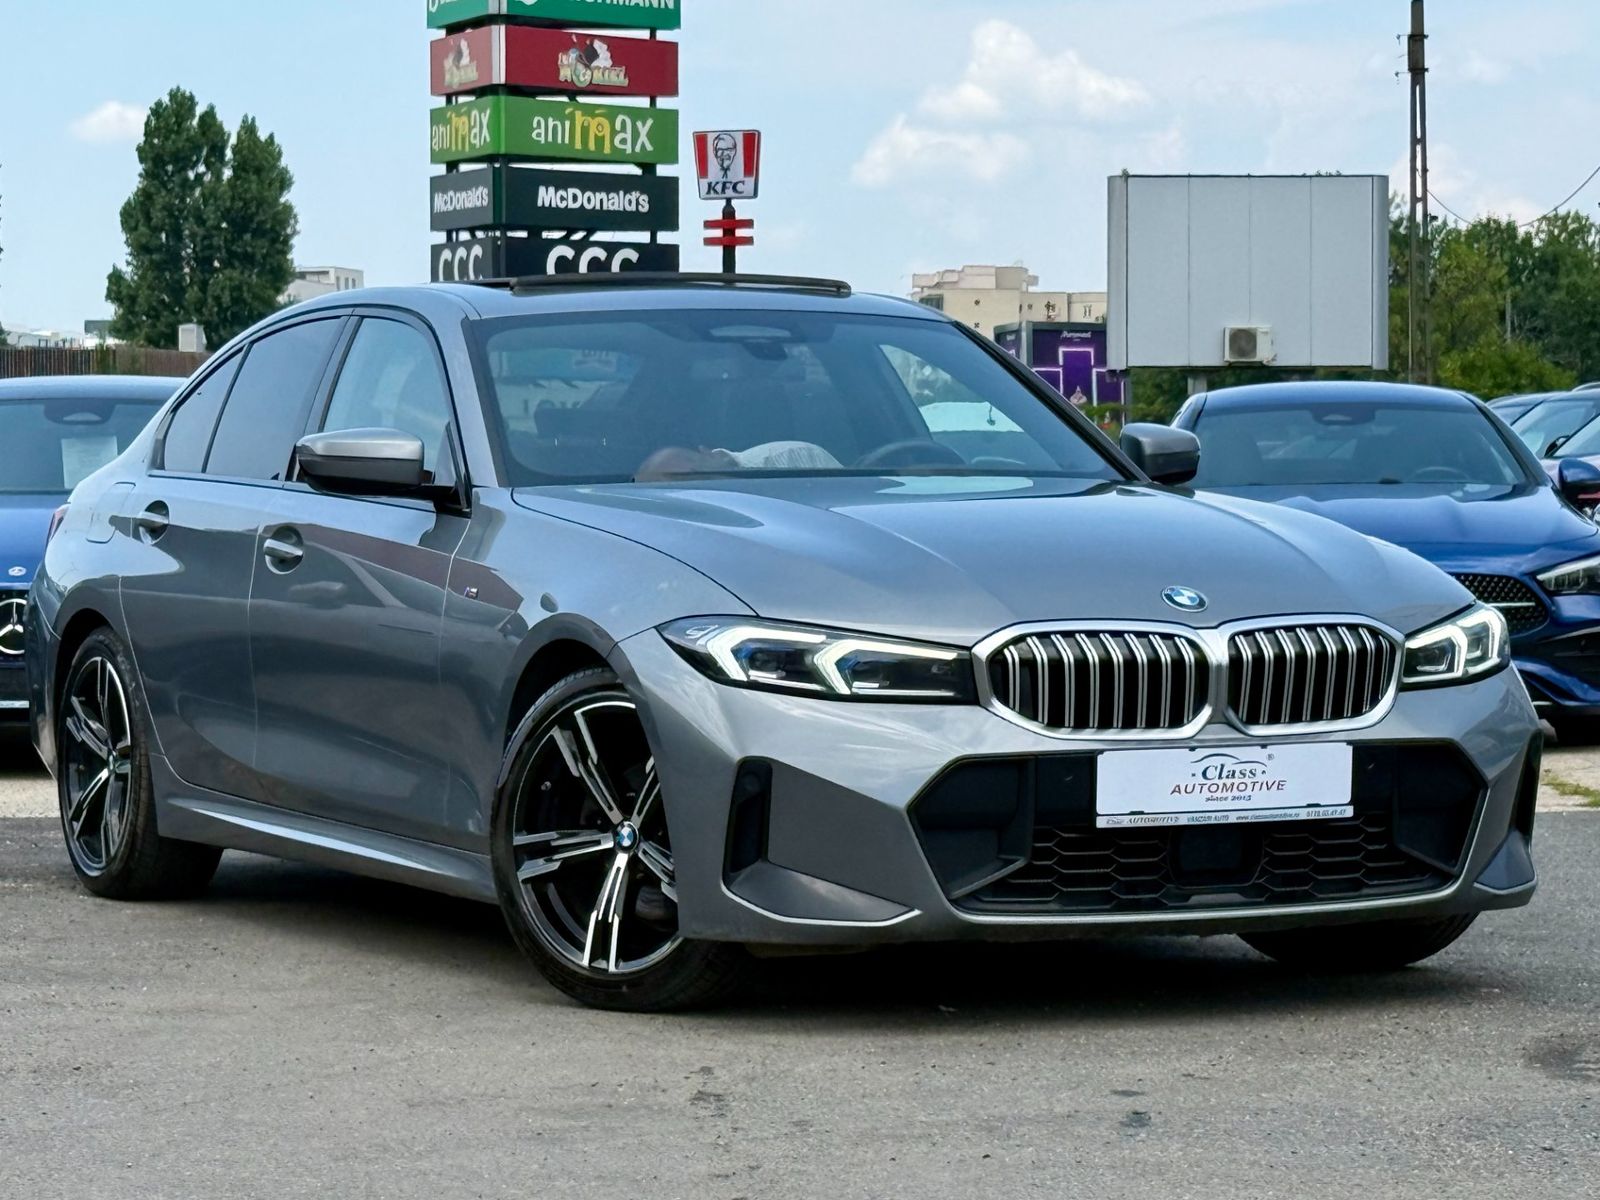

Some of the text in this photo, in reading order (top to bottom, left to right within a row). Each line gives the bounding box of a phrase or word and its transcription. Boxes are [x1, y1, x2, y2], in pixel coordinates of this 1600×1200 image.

[431, 107, 491, 153] animax
[531, 107, 654, 154] animax
[434, 185, 489, 214] McDonald's
[537, 185, 650, 213] McDonald's
[705, 180, 745, 195] KFC
[438, 244, 483, 282] CCC
[1201, 763, 1257, 781] Class
[1170, 780, 1287, 796] AUTOMOTIVE
